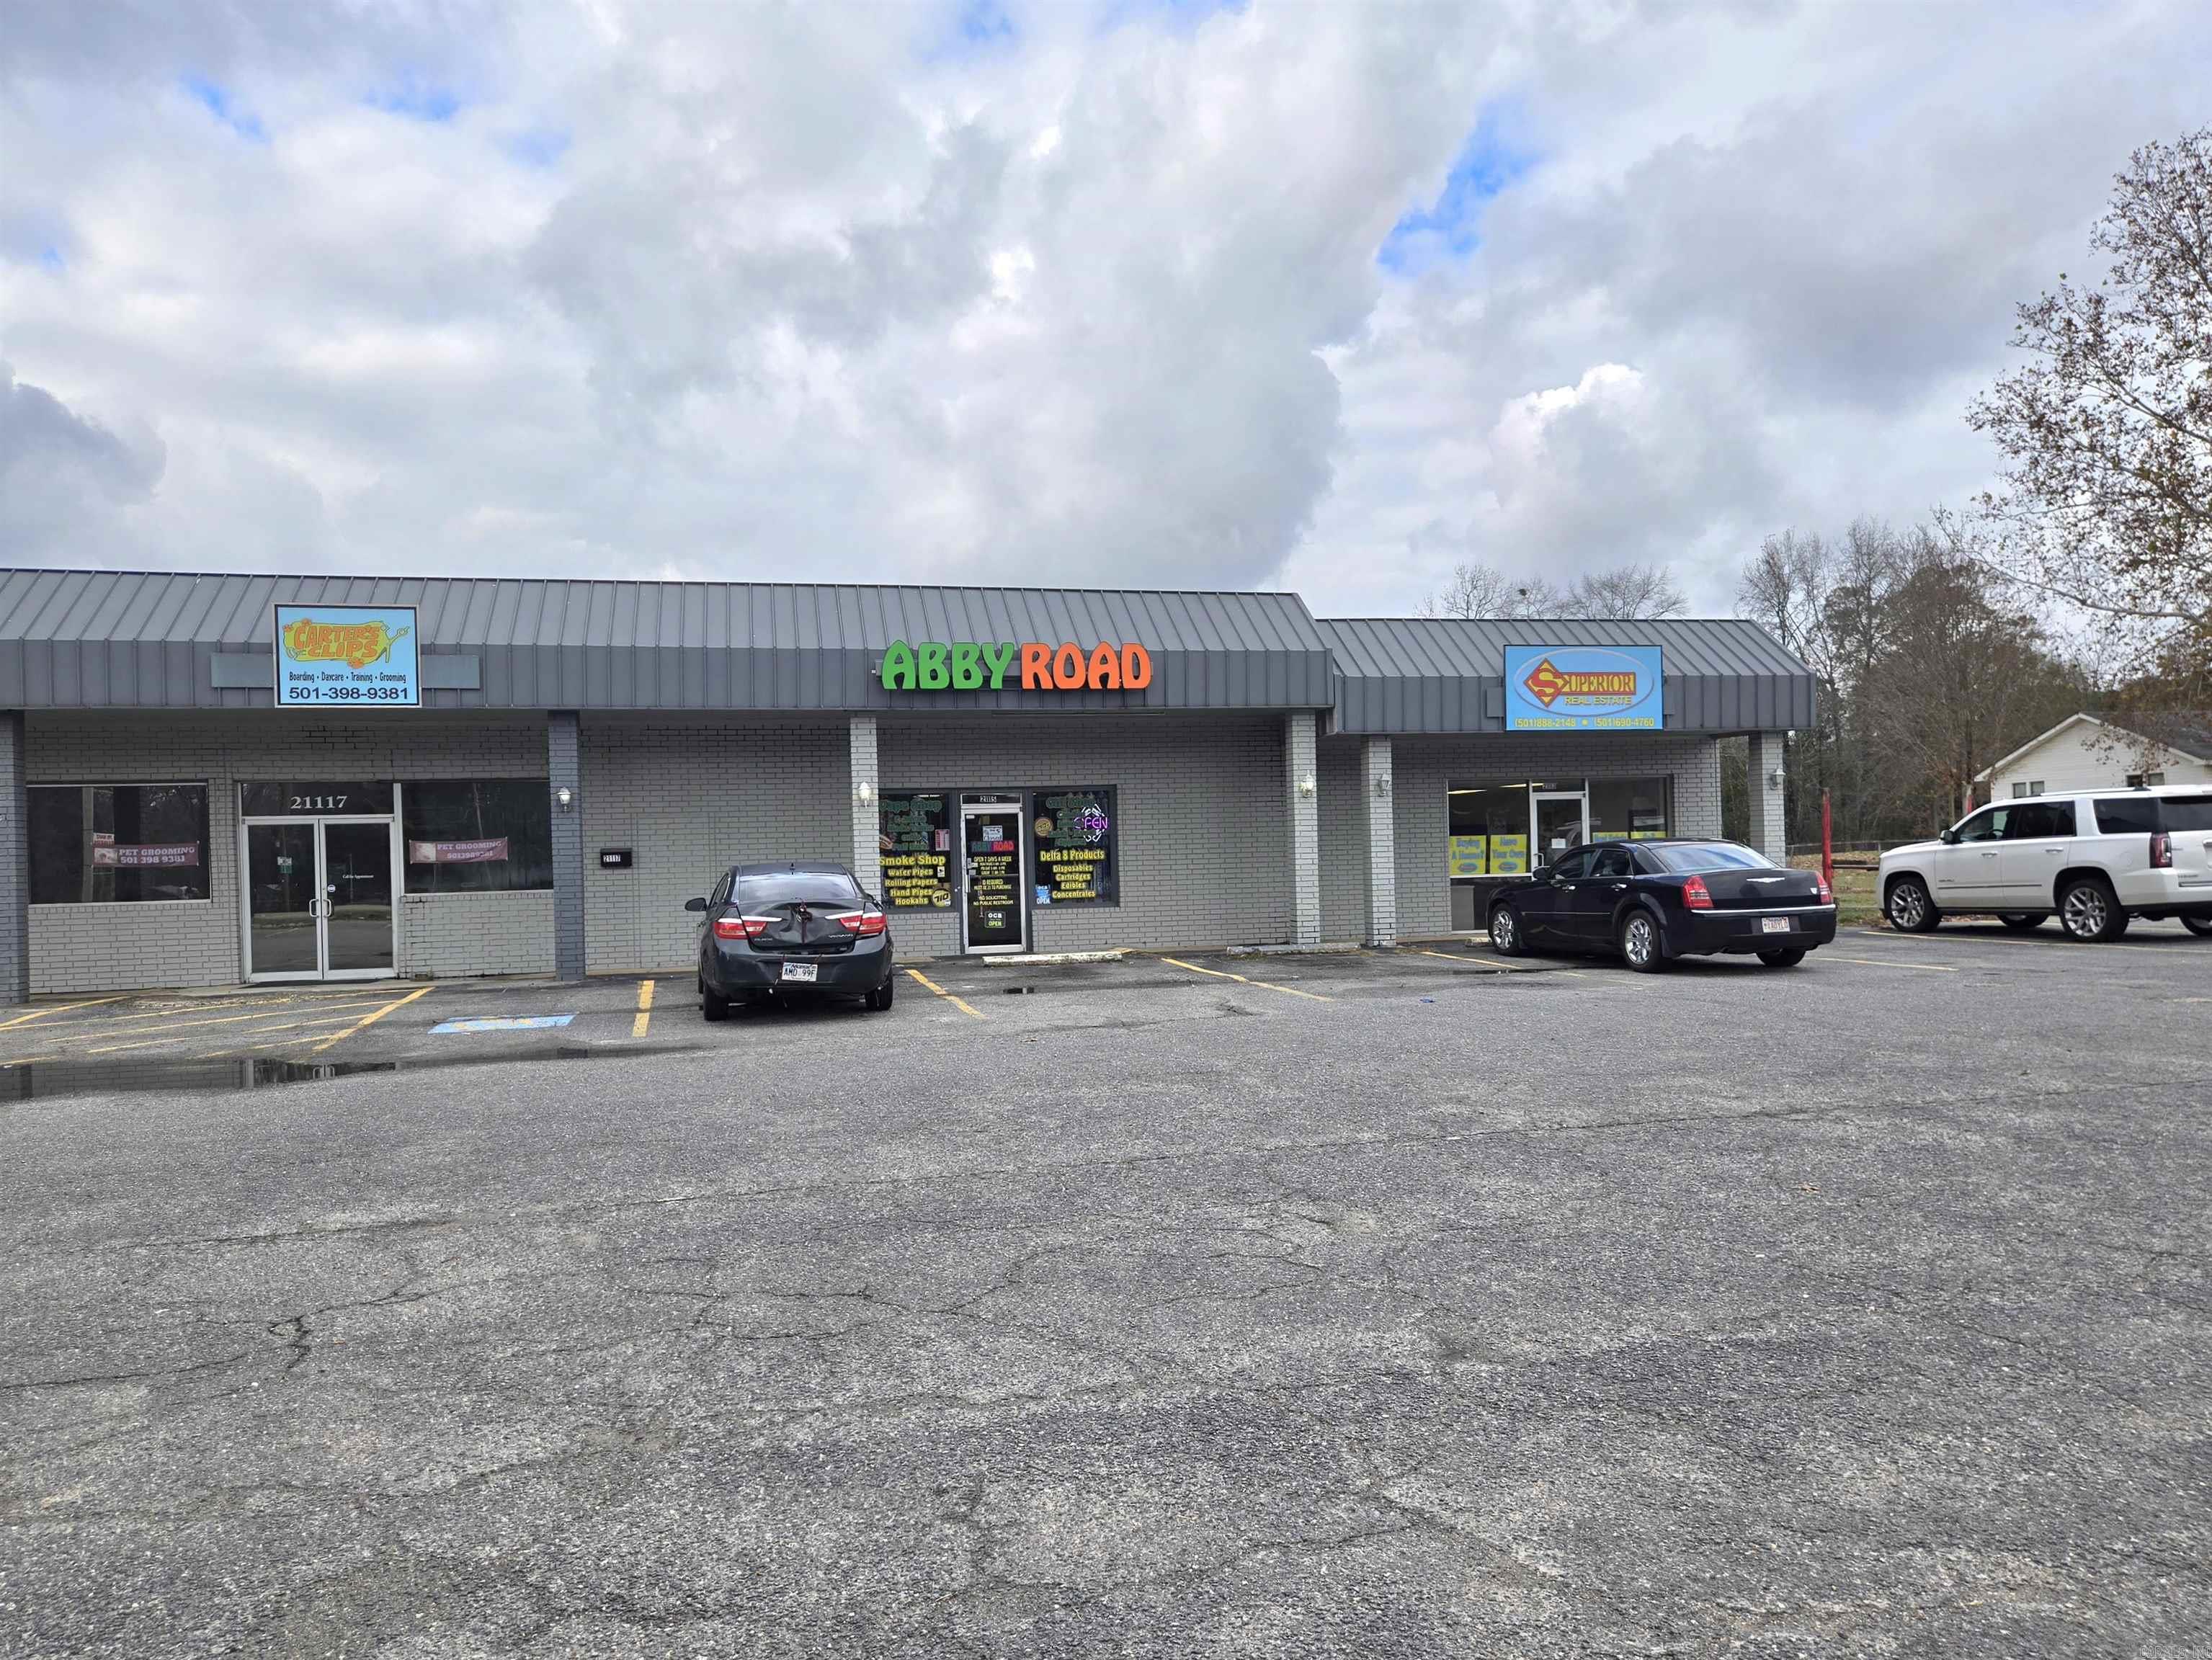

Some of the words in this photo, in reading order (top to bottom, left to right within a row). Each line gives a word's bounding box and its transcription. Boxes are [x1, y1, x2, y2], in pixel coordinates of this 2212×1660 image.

[293, 625, 380, 650] CARTER'S
[308, 640, 378, 658] CLIPS
[881, 639, 1014, 690] ABBY
[1020, 640, 1151, 690] ROAD
[289, 671, 315, 683] Boarding
[321, 671, 344, 682] Daycare
[351, 671, 373, 683] Training
[379, 671, 406, 684] Grooming
[289, 687, 409, 700] 501-398-9381
[1565, 697, 1591, 705] REAL
[1594, 696, 1633, 705] ESTATE
[290, 795, 347, 808] 21117
[1074, 816, 1108, 829] OPEN
[455, 841, 502, 850] GROOMING
[992, 841, 1015, 852] ROAD
[141, 847, 195, 856] GROOMING
[1040, 849, 1061, 861] Delta
[1062, 849, 1069, 861] 8
[1069, 849, 1105, 860] Products
[879, 855, 916, 865] Smoke
[917, 854, 946, 865] Shop
[1061, 881, 1086, 890] Edibles
[890, 888, 910, 897] Hand
[802, 969, 817, 978] 99F
